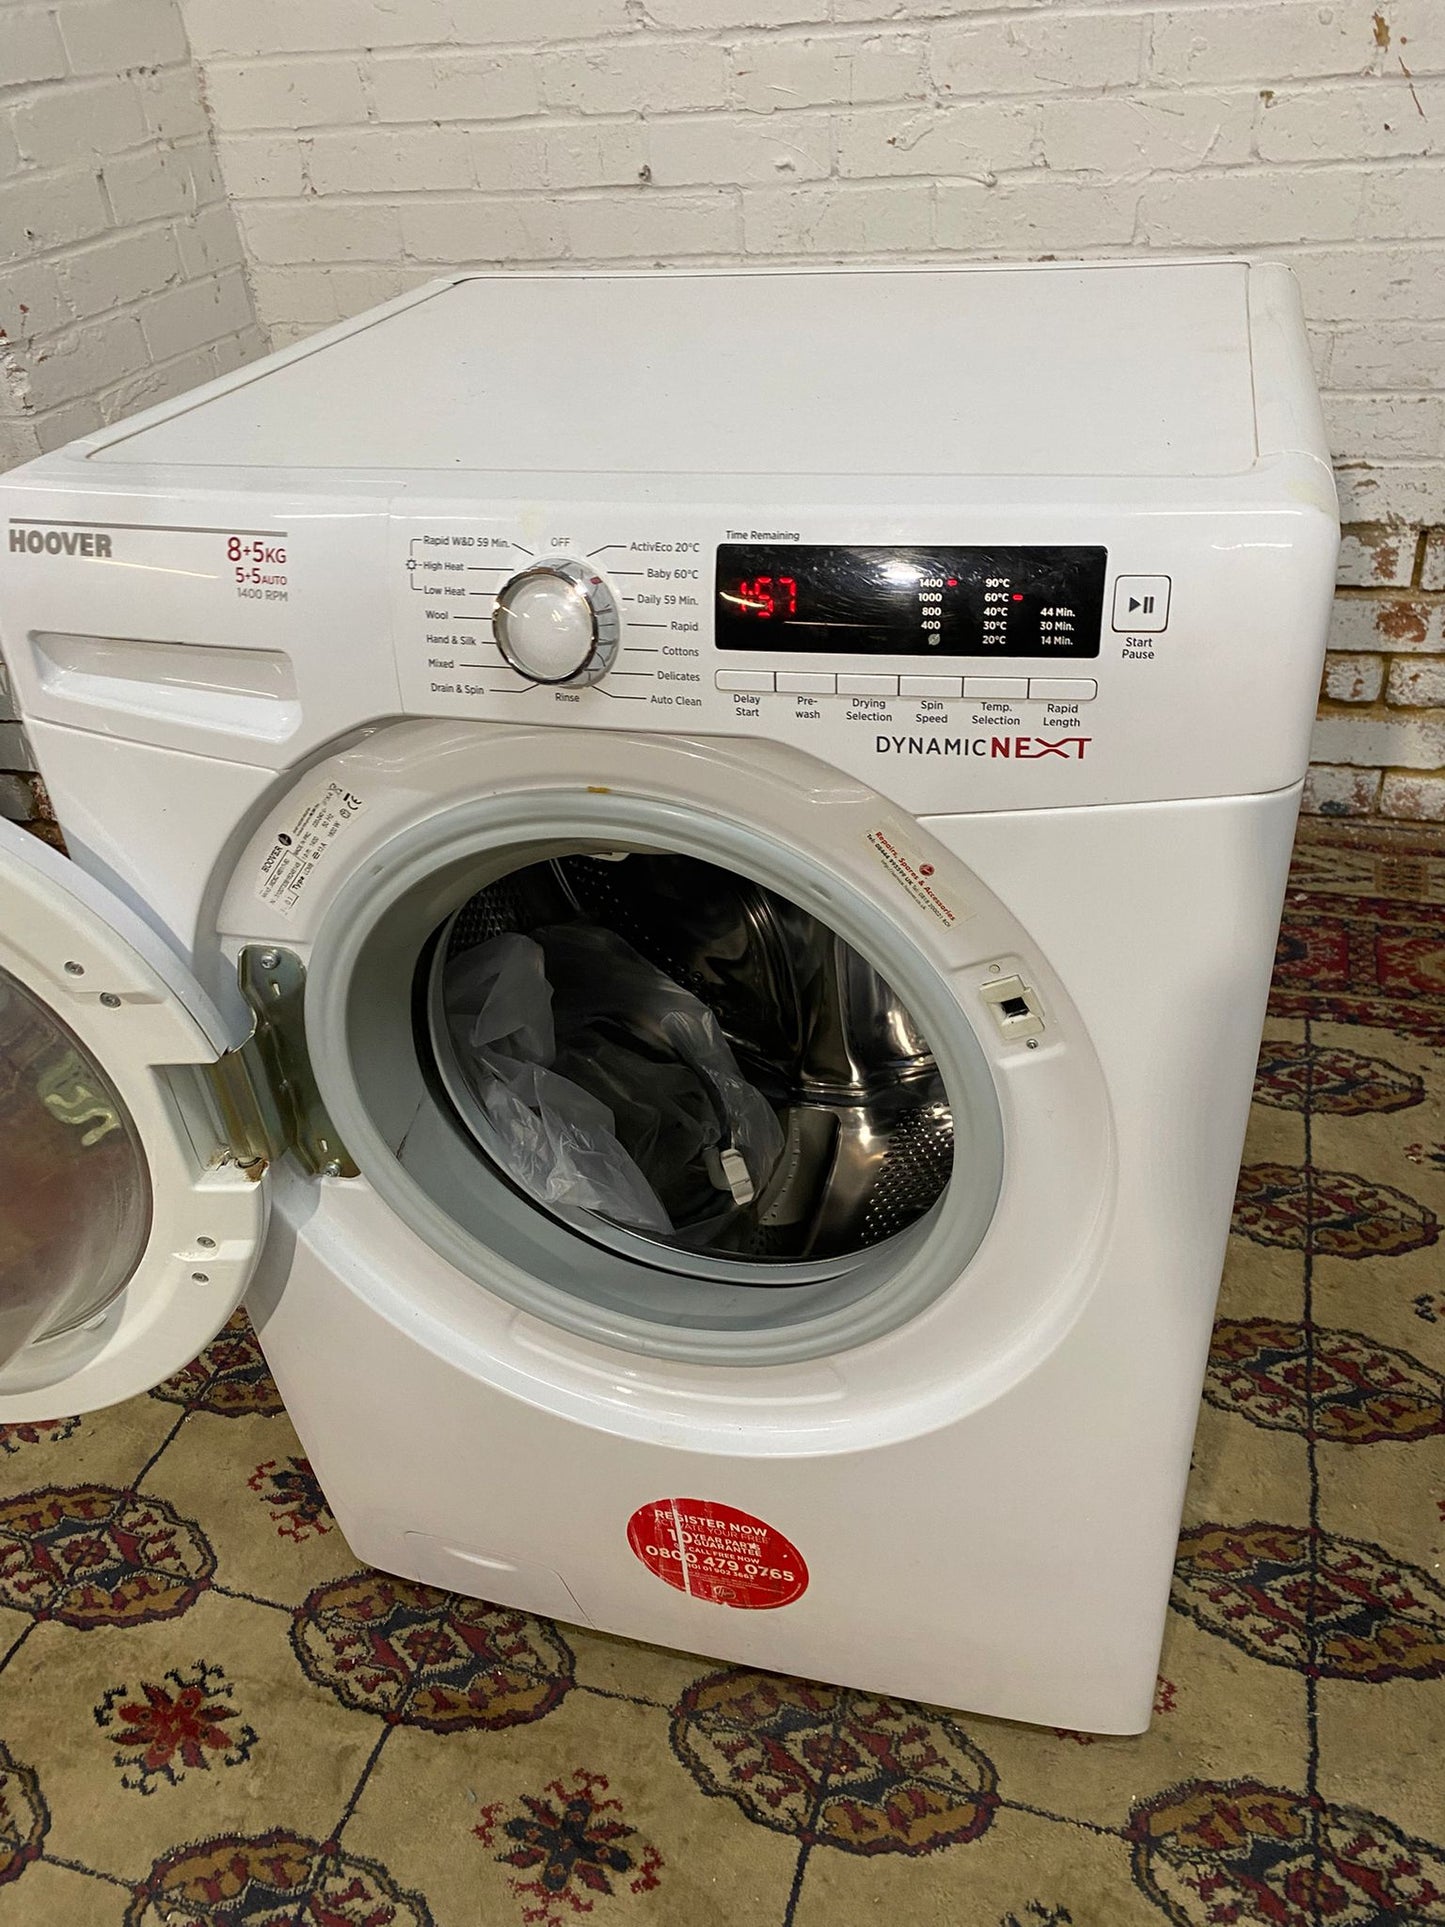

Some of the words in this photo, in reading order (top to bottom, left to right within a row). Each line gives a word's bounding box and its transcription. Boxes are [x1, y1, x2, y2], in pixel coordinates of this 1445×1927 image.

[423, 535, 449, 547] Rapid
[452, 537, 474, 546] W&D
[477, 537, 489, 547] 59
[492, 538, 510, 547] Min.
[726, 531, 748, 540] Time
[751, 531, 800, 541] Remaining
[9, 530, 112, 557] HOOVER
[551, 538, 570, 547] OFF
[630, 542, 672, 552] ActivEco
[676, 542, 700, 552] 20°C
[228, 537, 286, 563] 8+5KG
[423, 562, 442, 572] High
[444, 563, 464, 572] Heat
[648, 569, 670, 580] Baby
[674, 569, 698, 579] 60°C
[920, 579, 942, 588] 1400
[986, 578, 1010, 588] 90°C
[237, 588, 262, 599] 1400
[265, 590, 288, 601] RPM
[425, 586, 441, 595] Low
[444, 586, 465, 596] Heat
[638, 594, 662, 606] Daily
[665, 595, 676, 605] 59
[679, 596, 699, 605] Min.
[919, 594, 942, 602] 1000
[984, 593, 1008, 602] 60°C
[426, 610, 448, 619] Wool
[922, 608, 941, 616] 800
[984, 608, 1008, 616] 40°C
[1040, 608, 1054, 616] 44
[1056, 608, 1075, 617] Min.
[672, 622, 698, 633] Rapid
[921, 621, 940, 630] 400
[983, 621, 1006, 630] 30°C
[1040, 622, 1052, 630] 30
[1054, 622, 1074, 630] Min.
[427, 635, 449, 645] Hand
[452, 636, 459, 644] &
[460, 636, 476, 645] Silk
[982, 636, 1006, 644] 20°C
[1041, 636, 1052, 644] 14
[1054, 636, 1073, 645] Min.
[1126, 638, 1152, 647] Start
[663, 647, 699, 657] Cottons
[1122, 650, 1154, 659] Pause
[429, 660, 454, 669] Mixed
[657, 671, 700, 681] Delicates
[431, 683, 454, 693] Drain
[456, 684, 462, 693] &
[465, 685, 484, 695] Spin
[555, 693, 580, 703] Rinse
[651, 695, 673, 705] Auto
[675, 696, 701, 707] Clean
[734, 694, 760, 704] Delay
[797, 696, 817, 706] Pre-
[853, 699, 886, 709] Drying
[921, 701, 943, 711] Spin
[981, 703, 1012, 712] Temp.
[1048, 704, 1078, 714] Rapid
[736, 707, 759, 717] Start
[796, 710, 820, 719] wash
[847, 712, 892, 721] Selection
[916, 714, 948, 724] Speed
[972, 716, 1020, 726] Selection
[1044, 717, 1080, 728] Length
[867, 833, 875, 843] Tel:
[905, 877, 913, 885] UK
[875, 831, 898, 858] Repairs,
[898, 857, 919, 880] Spares
[924, 886, 955, 921] Accessories
[292, 876, 305, 890] Type
[708, 1527, 739, 1538] YOUR
[730, 1524, 767, 1536] NOW
[693, 1532, 723, 1543] YEAR
[694, 1540, 762, 1557] GUARANTEE
[689, 1547, 711, 1556] CALL
[713, 1551, 737, 1561] FREE
[738, 1556, 760, 1564] NOW
[646, 1545, 698, 1563] 0800
[704, 1556, 739, 1571] 479
[745, 1564, 794, 1582] 0765
